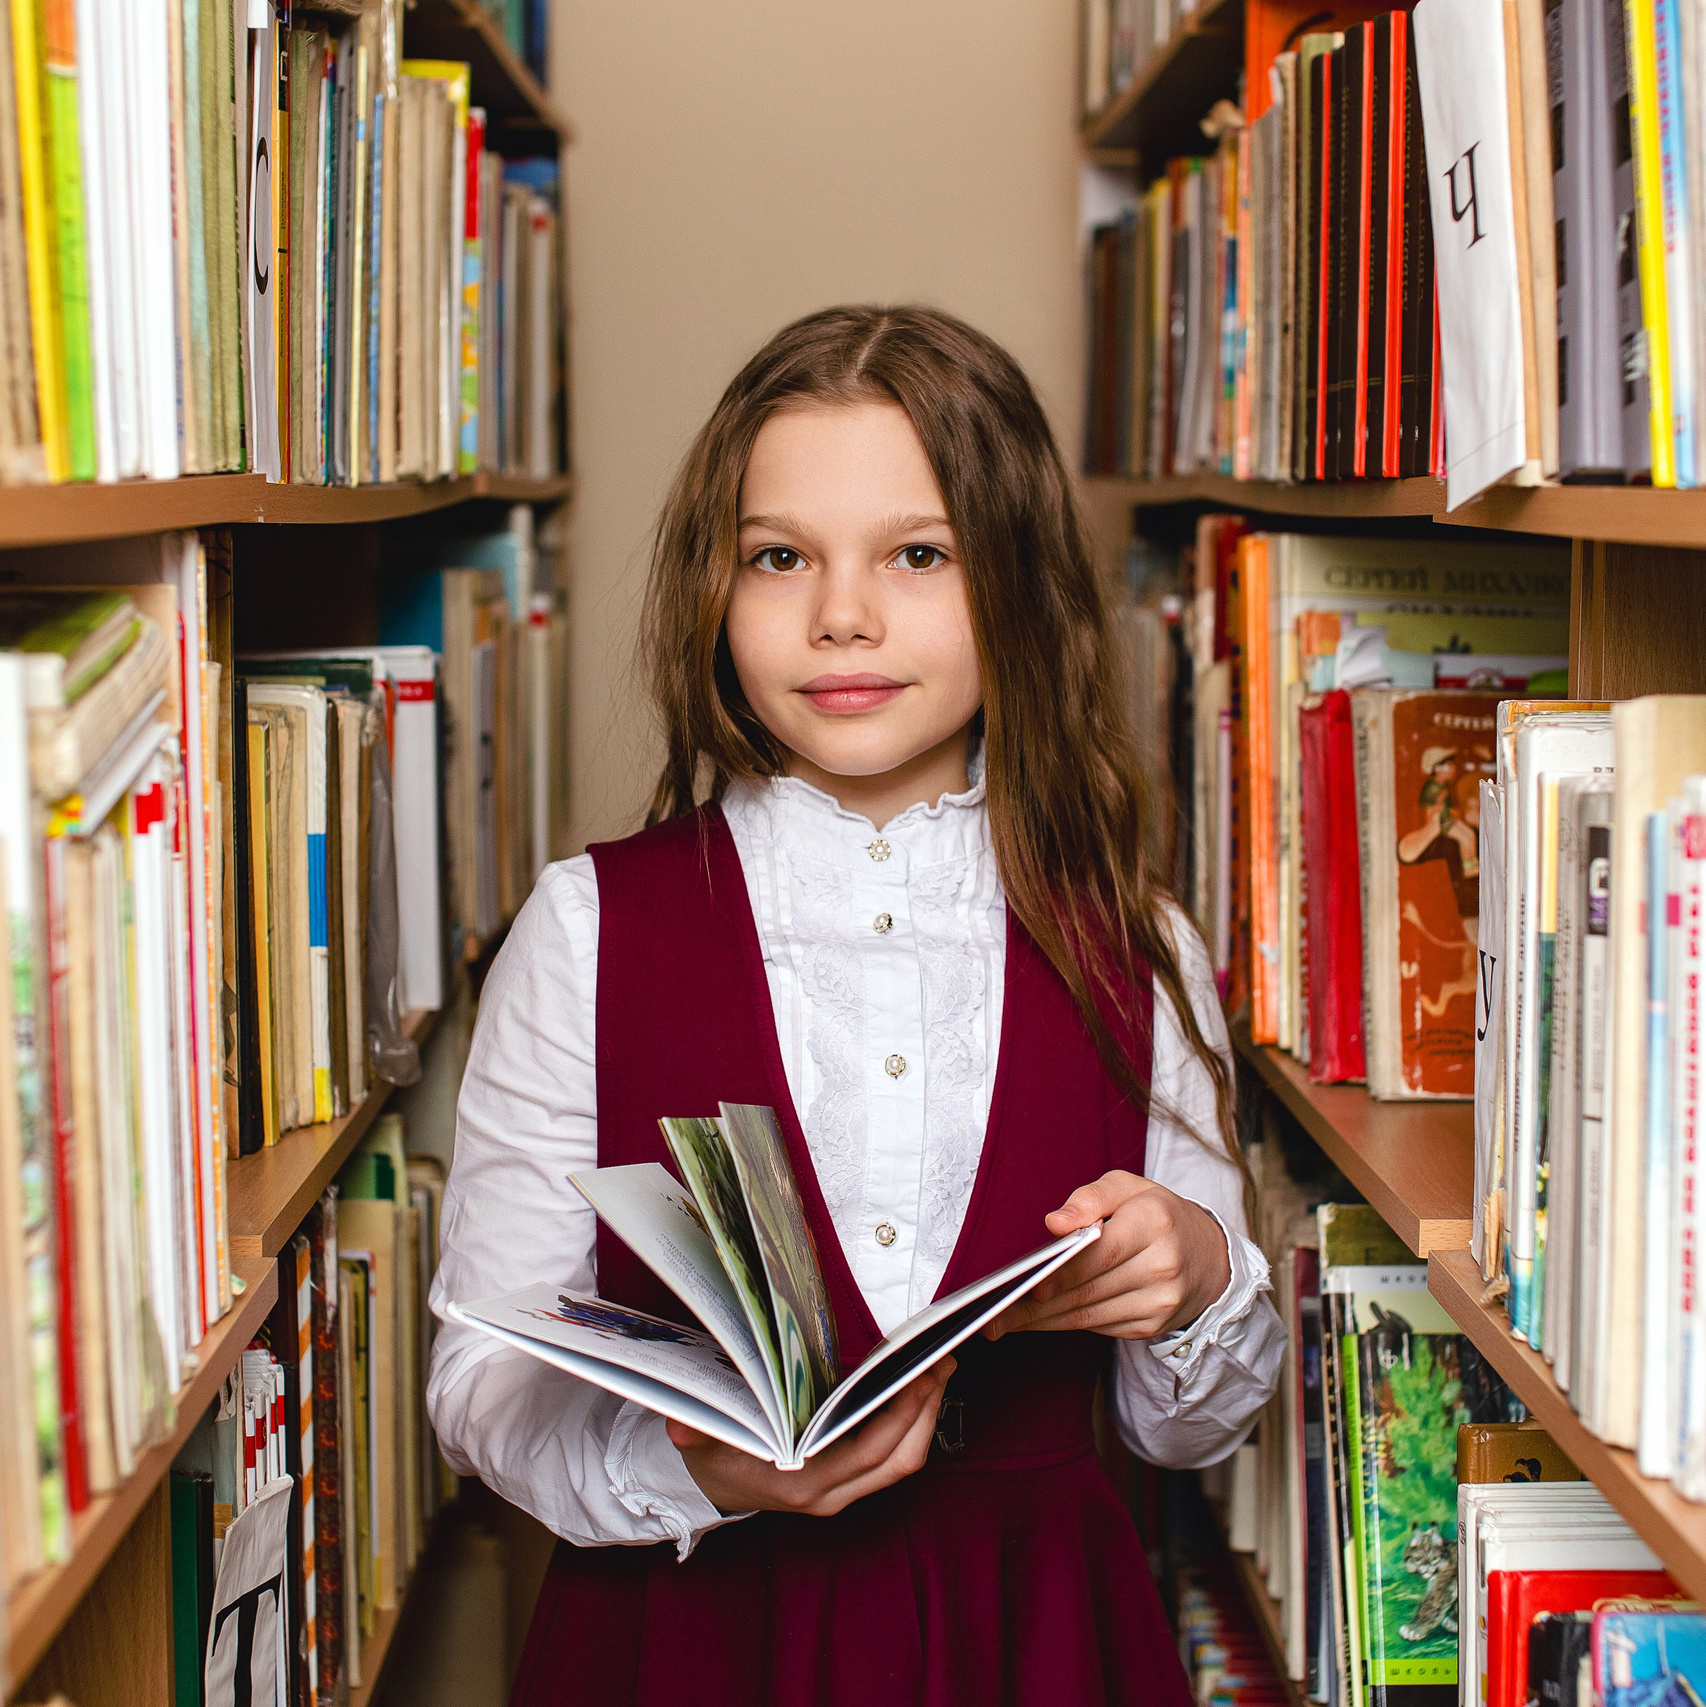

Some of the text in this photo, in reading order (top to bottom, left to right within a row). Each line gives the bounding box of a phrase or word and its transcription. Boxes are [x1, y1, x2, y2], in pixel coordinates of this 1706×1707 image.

[255, 137, 269, 295] С
[1443, 141, 1487, 249] Ч
[1477, 948, 1497, 1042] У
[211, 1571, 283, 1707] Т
